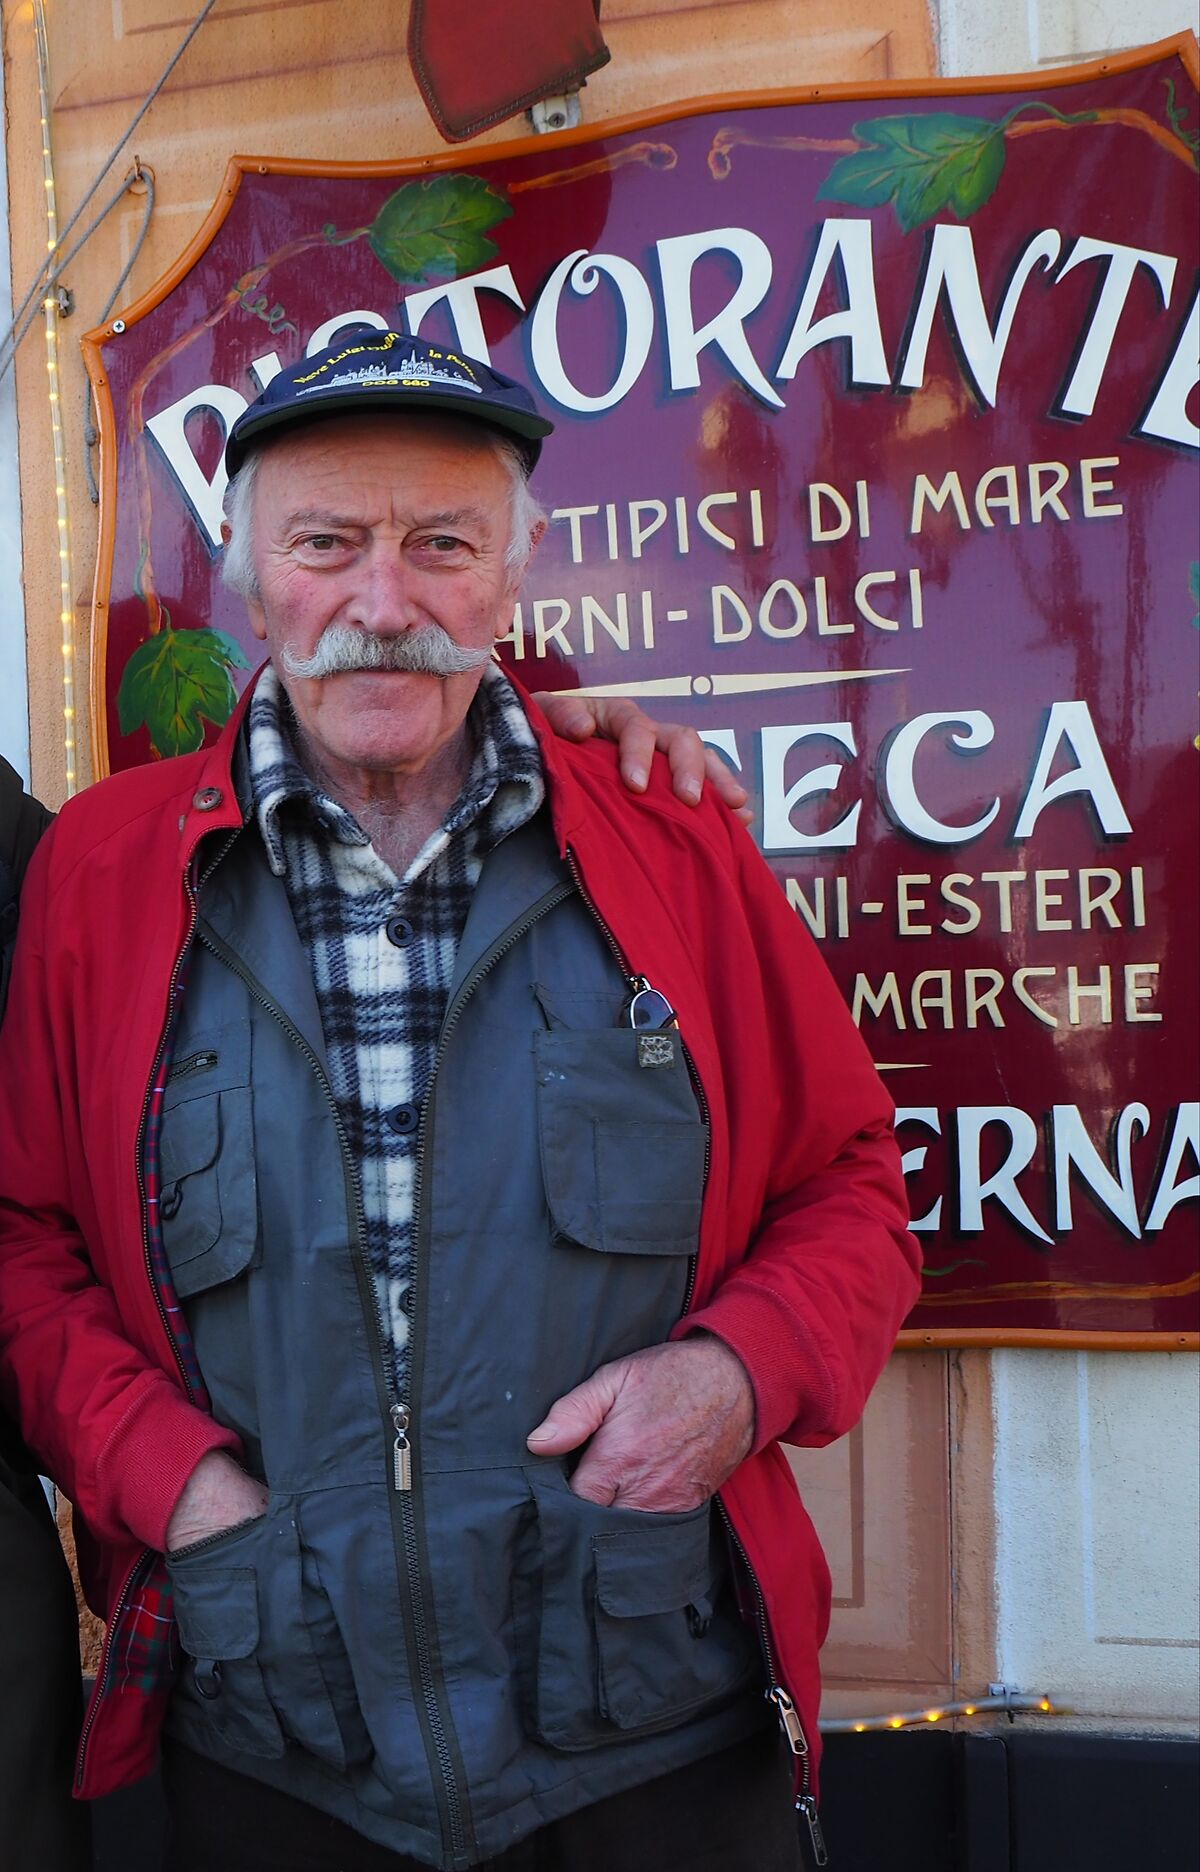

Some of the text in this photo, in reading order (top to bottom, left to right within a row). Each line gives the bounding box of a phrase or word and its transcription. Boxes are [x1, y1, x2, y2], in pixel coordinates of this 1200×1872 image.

[145, 218, 1200, 547] RTORANT
[551, 457, 1124, 563] TIPICI DI MARE
[491, 569, 923, 661] ARNI-DOLCI
[786, 866, 1146, 939] NI-ESTERI
[852, 963, 1163, 1030] MARCHE
[894, 1102, 1200, 1246] ERNA
